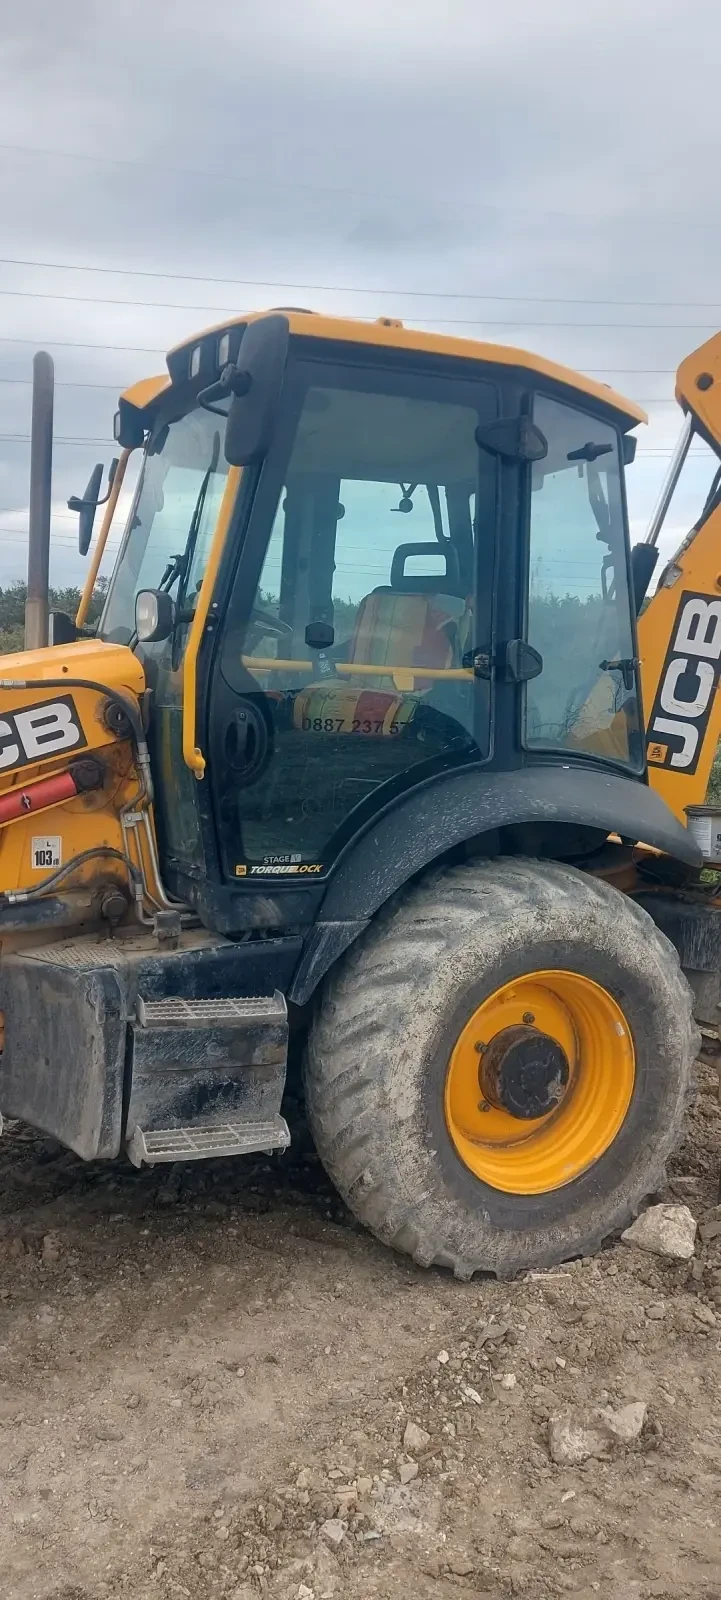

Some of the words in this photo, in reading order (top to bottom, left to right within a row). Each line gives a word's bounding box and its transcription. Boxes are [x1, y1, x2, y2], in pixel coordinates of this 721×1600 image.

[653, 598, 721, 768] JCB
[303, 717, 345, 732] 0887
[351, 719, 384, 734] 237
[35, 850, 53, 866] 103
[263, 855, 290, 864] STAGE
[250, 865, 323, 874] TORQUELOCK
